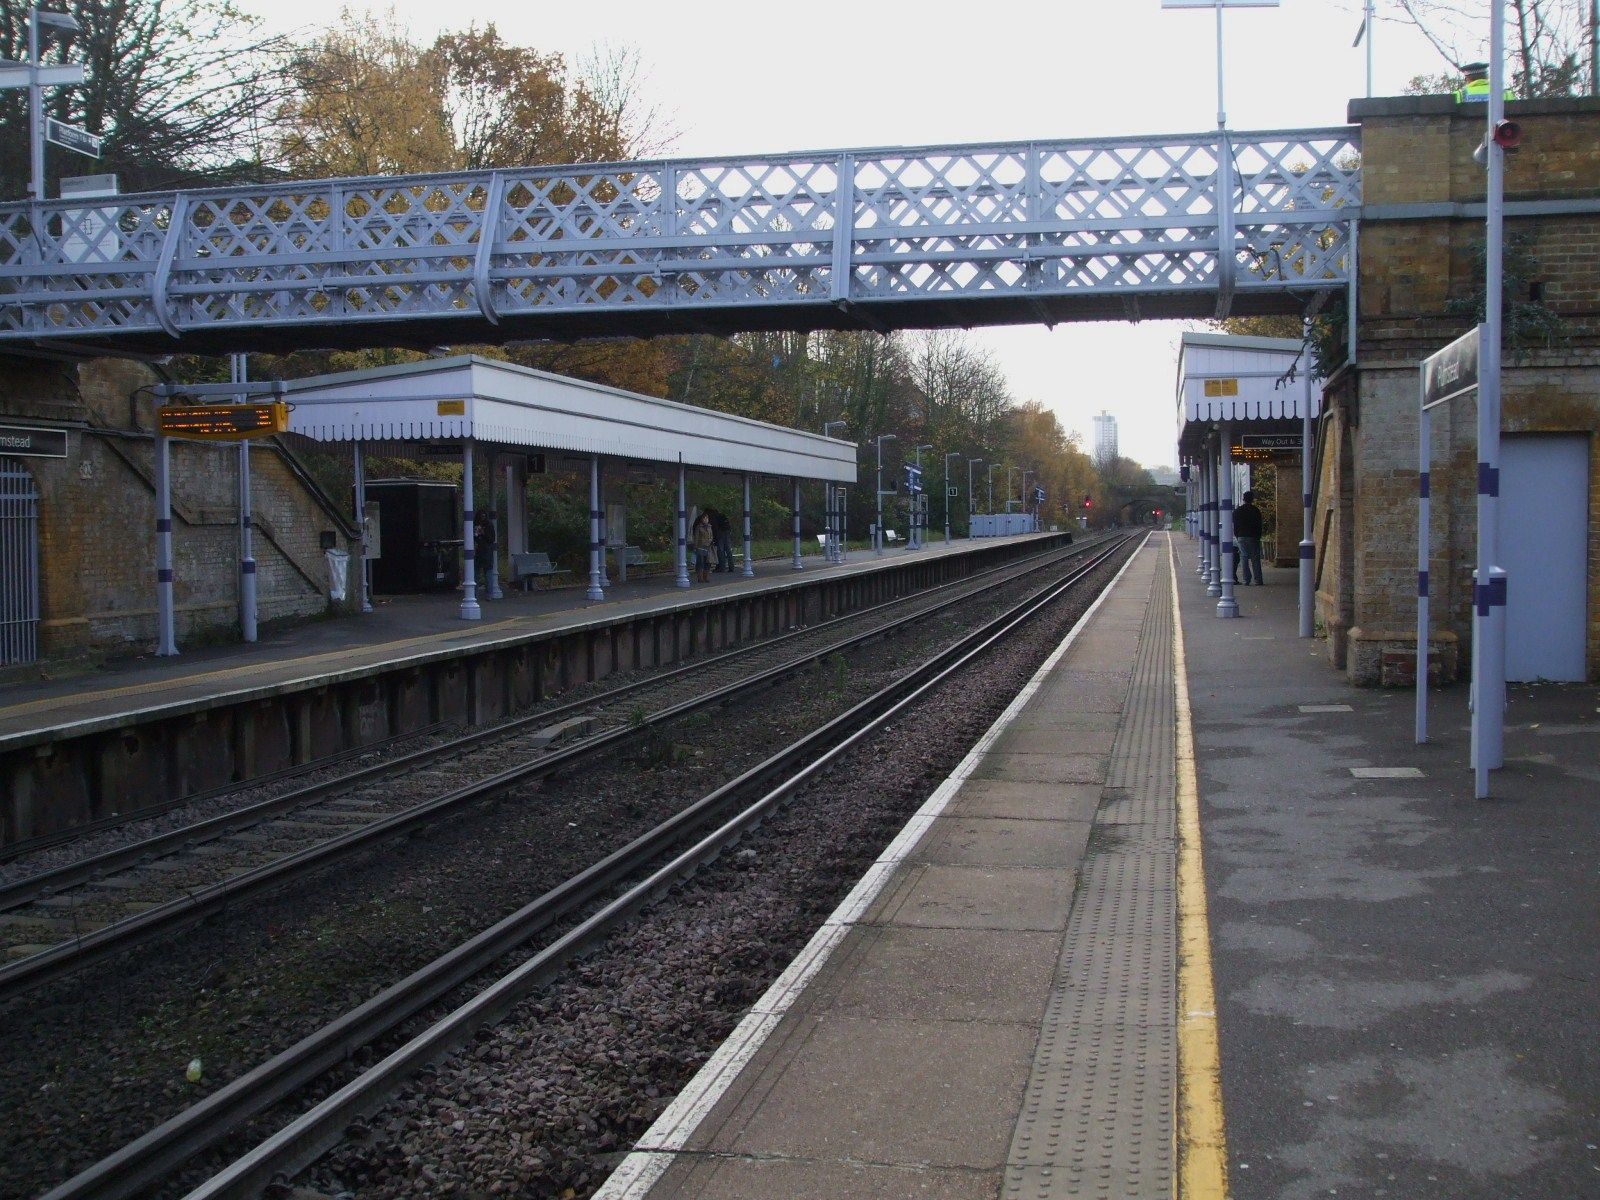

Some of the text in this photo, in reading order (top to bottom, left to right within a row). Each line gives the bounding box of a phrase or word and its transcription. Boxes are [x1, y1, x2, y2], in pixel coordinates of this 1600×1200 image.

[58, 126, 79, 140] Platform
[1262, 438, 1275, 447] Way
[1275, 438, 1289, 446] Out
